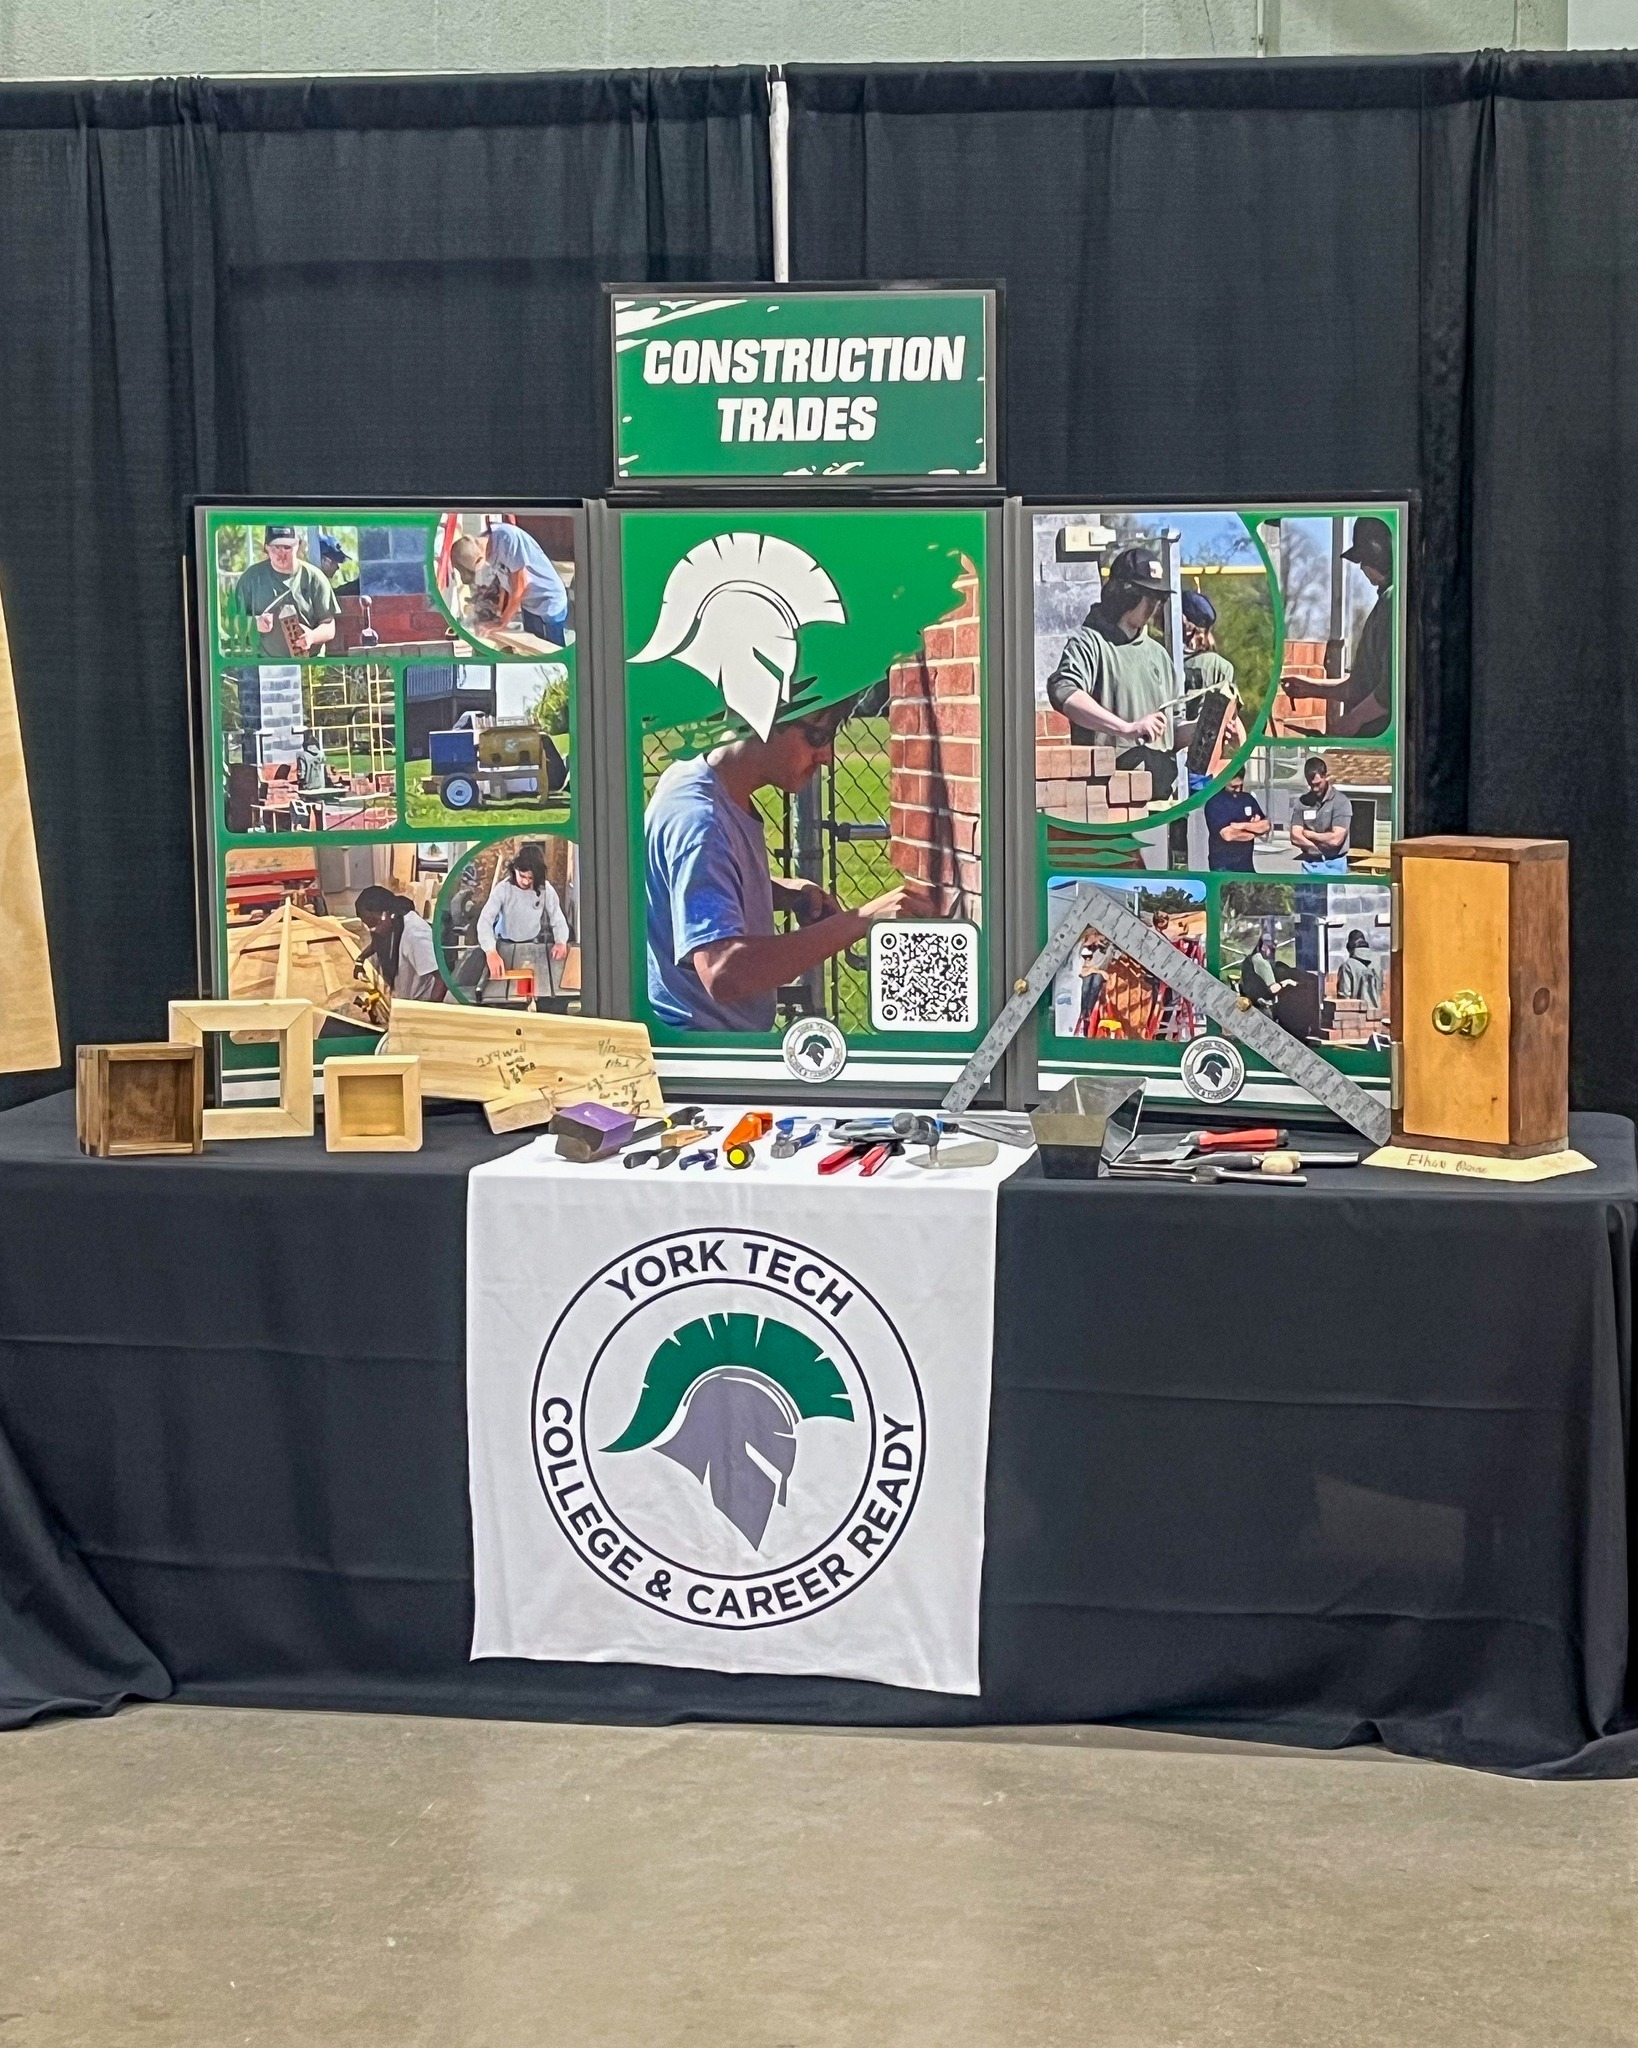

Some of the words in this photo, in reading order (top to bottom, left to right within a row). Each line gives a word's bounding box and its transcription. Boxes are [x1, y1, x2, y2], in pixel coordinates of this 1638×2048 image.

[642, 335, 967, 385] CONSTRUCTION
[716, 396, 879, 443] TRADES
[603, 1239, 728, 1301] YORK
[743, 1242, 854, 1317] TECH
[542, 1397, 643, 1582] COLLEGE
[645, 1569, 672, 1602] &
[687, 1553, 855, 1620] CAREER
[846, 1413, 914, 1559] READY
